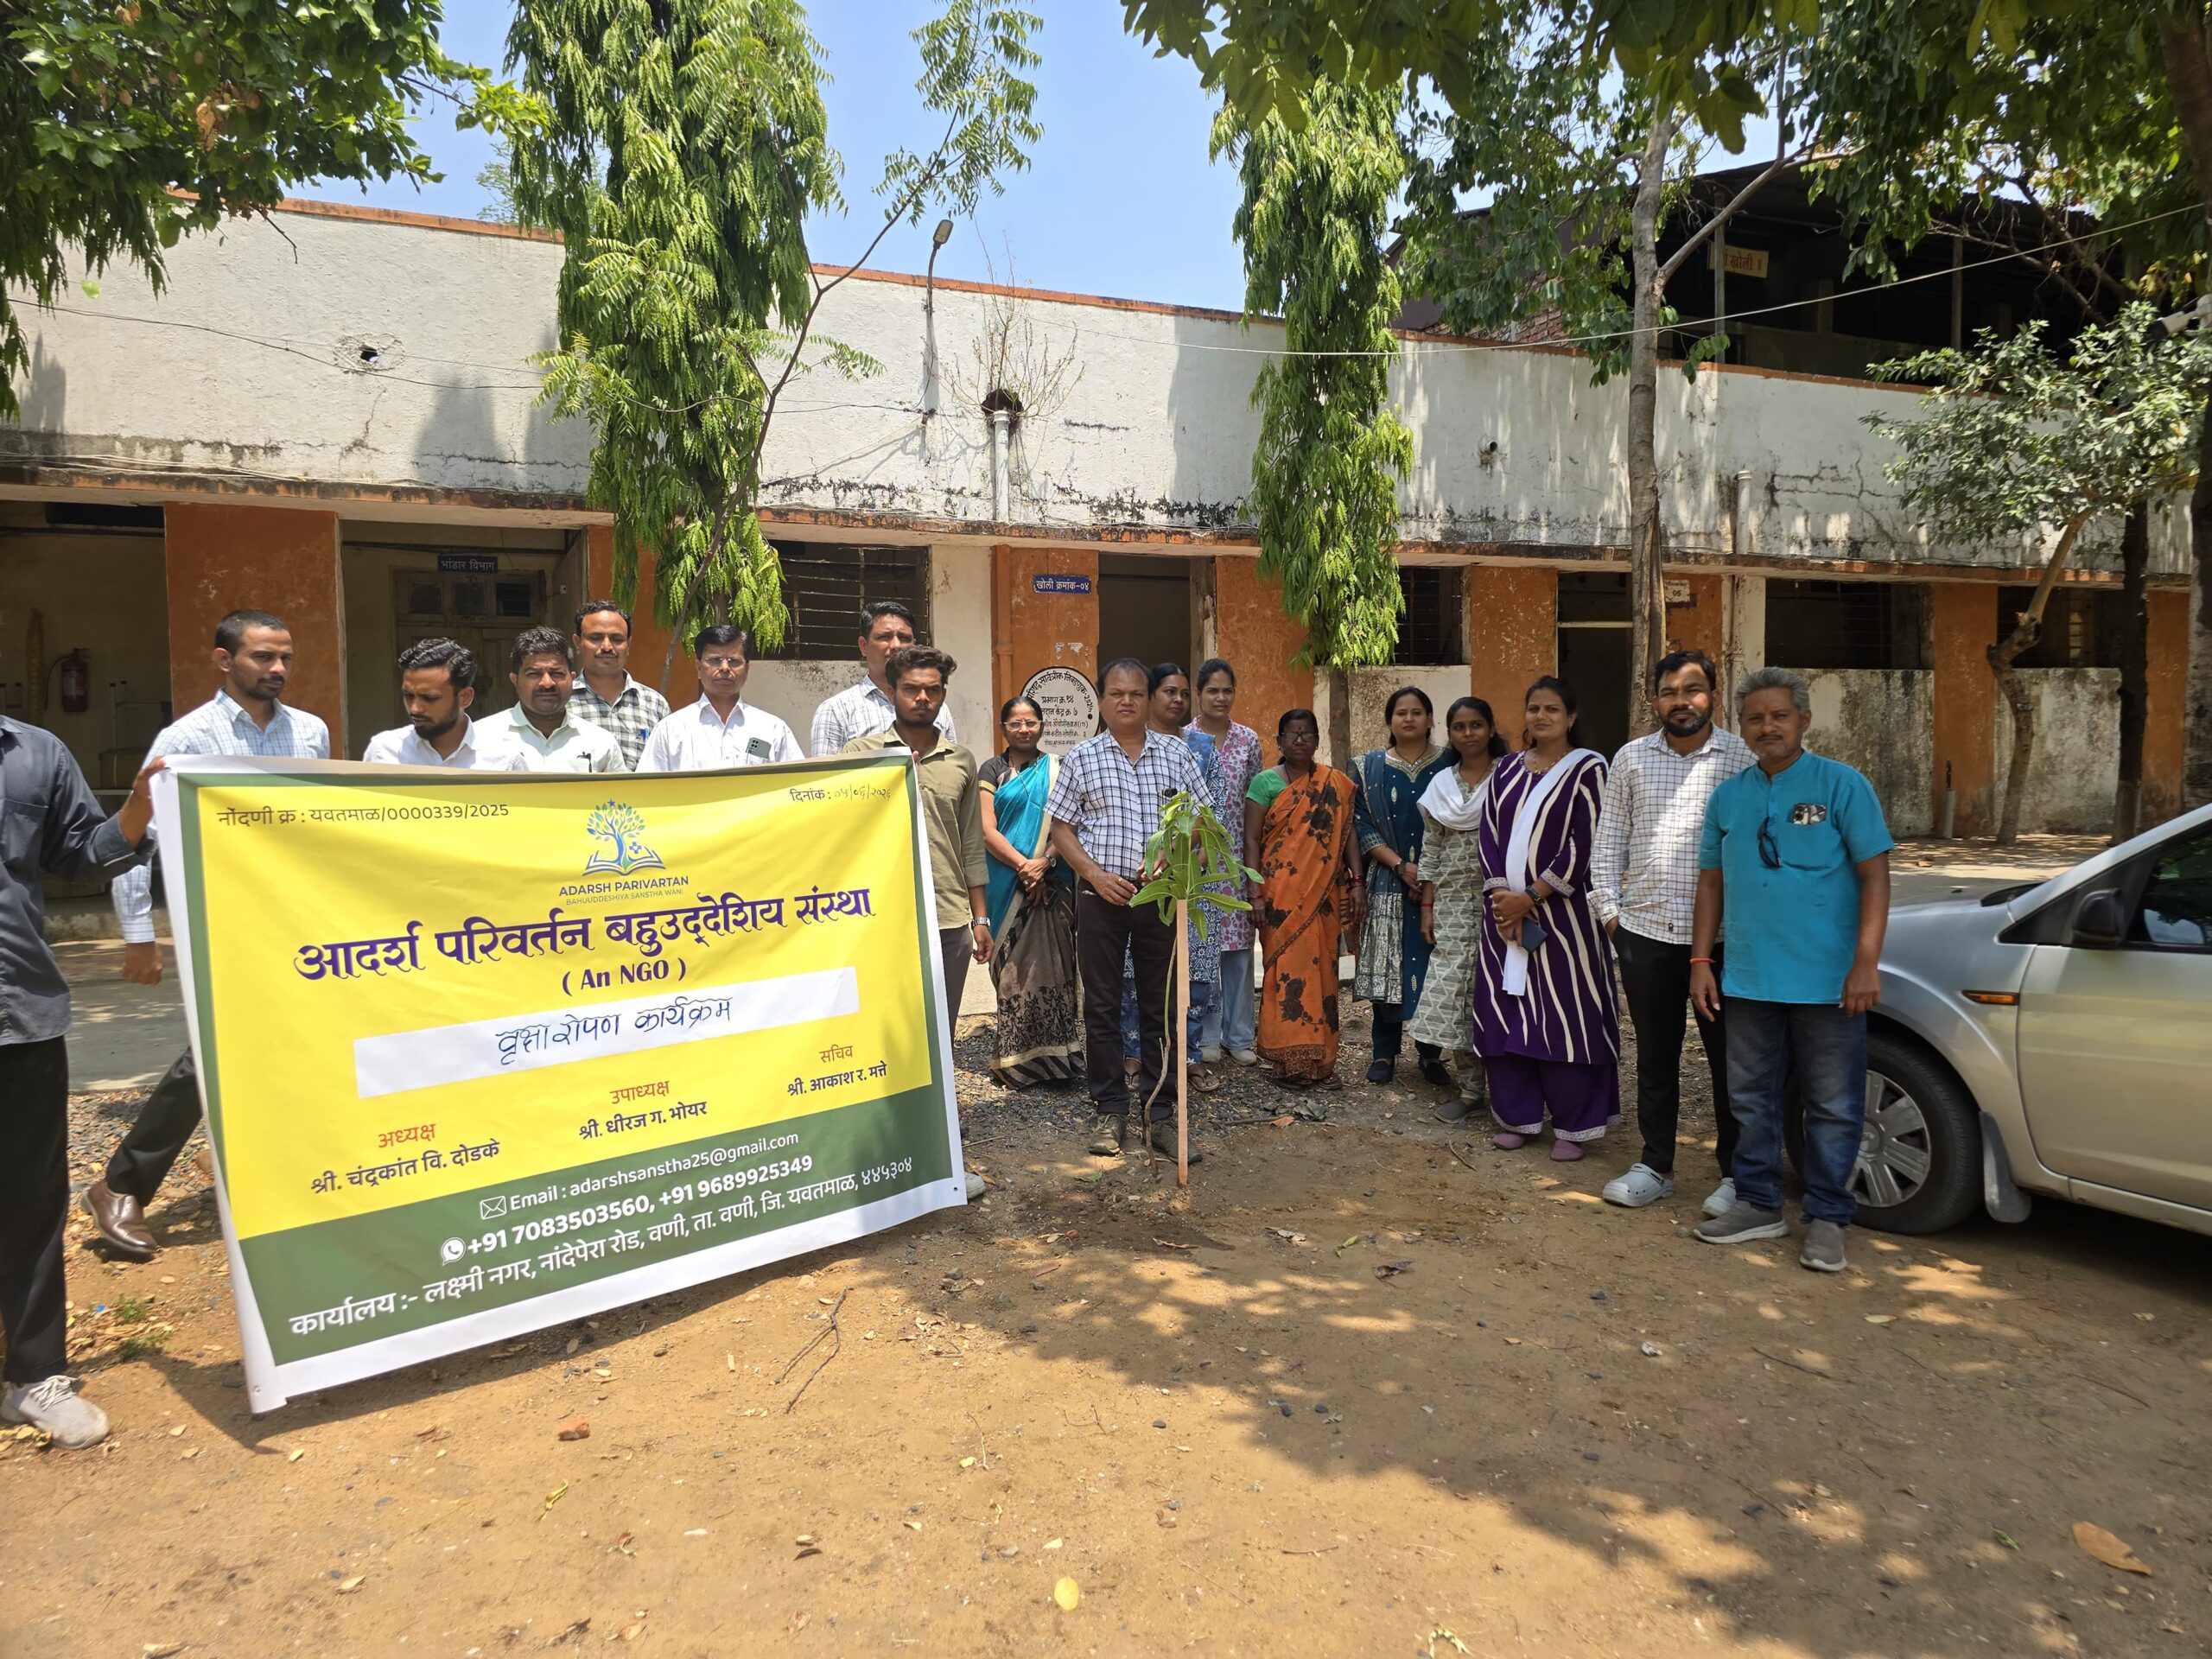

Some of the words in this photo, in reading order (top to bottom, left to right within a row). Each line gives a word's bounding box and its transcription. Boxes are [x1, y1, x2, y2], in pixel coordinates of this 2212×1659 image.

[469, 558, 495, 570] विभाग
[1036, 578, 1053, 590] खोली
[1056, 579, 1090, 591] क्रमांक-०४
[217, 806, 273, 827] नोंदणी
[309, 804, 510, 823] यवतमाळ/0000339/2025
[558, 882, 611, 897] ADARSH
[614, 875, 690, 892] PARIVARTAN
[566, 894, 629, 906] BAHUUDDESHIYA
[631, 889, 663, 899] SANSTHA
[294, 920, 426, 980] आदर्श
[435, 907, 595, 964] परिवर्तन
[794, 885, 876, 925] संस्था
[580, 969, 611, 990] An
[620, 959, 670, 984] NGO
[634, 996, 733, 1032] कार्यक्रम
[819, 1046, 854, 1064] सचिव
[610, 1080, 671, 1105] उपाध्यक्ष
[787, 1078, 807, 1096] श्री.
[810, 1071, 854, 1091] आकाश
[856, 1069, 868, 1082] र.
[579, 1119, 603, 1140] श्री.
[606, 1109, 647, 1134] धीरज
[650, 1111, 667, 1125] ग.
[669, 1101, 707, 1121] भोयर
[378, 1123, 436, 1148] अध्यक्ष
[310, 1170, 342, 1194] श्री.
[346, 1157, 418, 1187] चंद्रकांत
[422, 1150, 448, 1169] वि.
[450, 1137, 500, 1166] दोडके
[510, 1189, 558, 1211] Email
[570, 1132, 799, 1194] adarshsanstha25@gmail.com
[467, 1230, 507, 1254] +91
[512, 1195, 655, 1247] 7083503560,
[658, 1184, 693, 1207] +91
[696, 1155, 813, 1199] 9689925349
[289, 1292, 397, 1336] कार्यालय
[423, 1266, 486, 1303] लक्ष्मी
[487, 1258, 537, 1285] नगर,
[538, 1237, 607, 1273] नांदेपेरा
[609, 1227, 645, 1251] रोड,
[647, 1212, 690, 1243] वणी,
[692, 1212, 716, 1232] ता.
[719, 1195, 758, 1223] वणी,
[760, 1191, 785, 1214] जि.
[788, 1173, 859, 1205] यवतमाळ,
[861, 1156, 913, 1186] ४४५३०४
